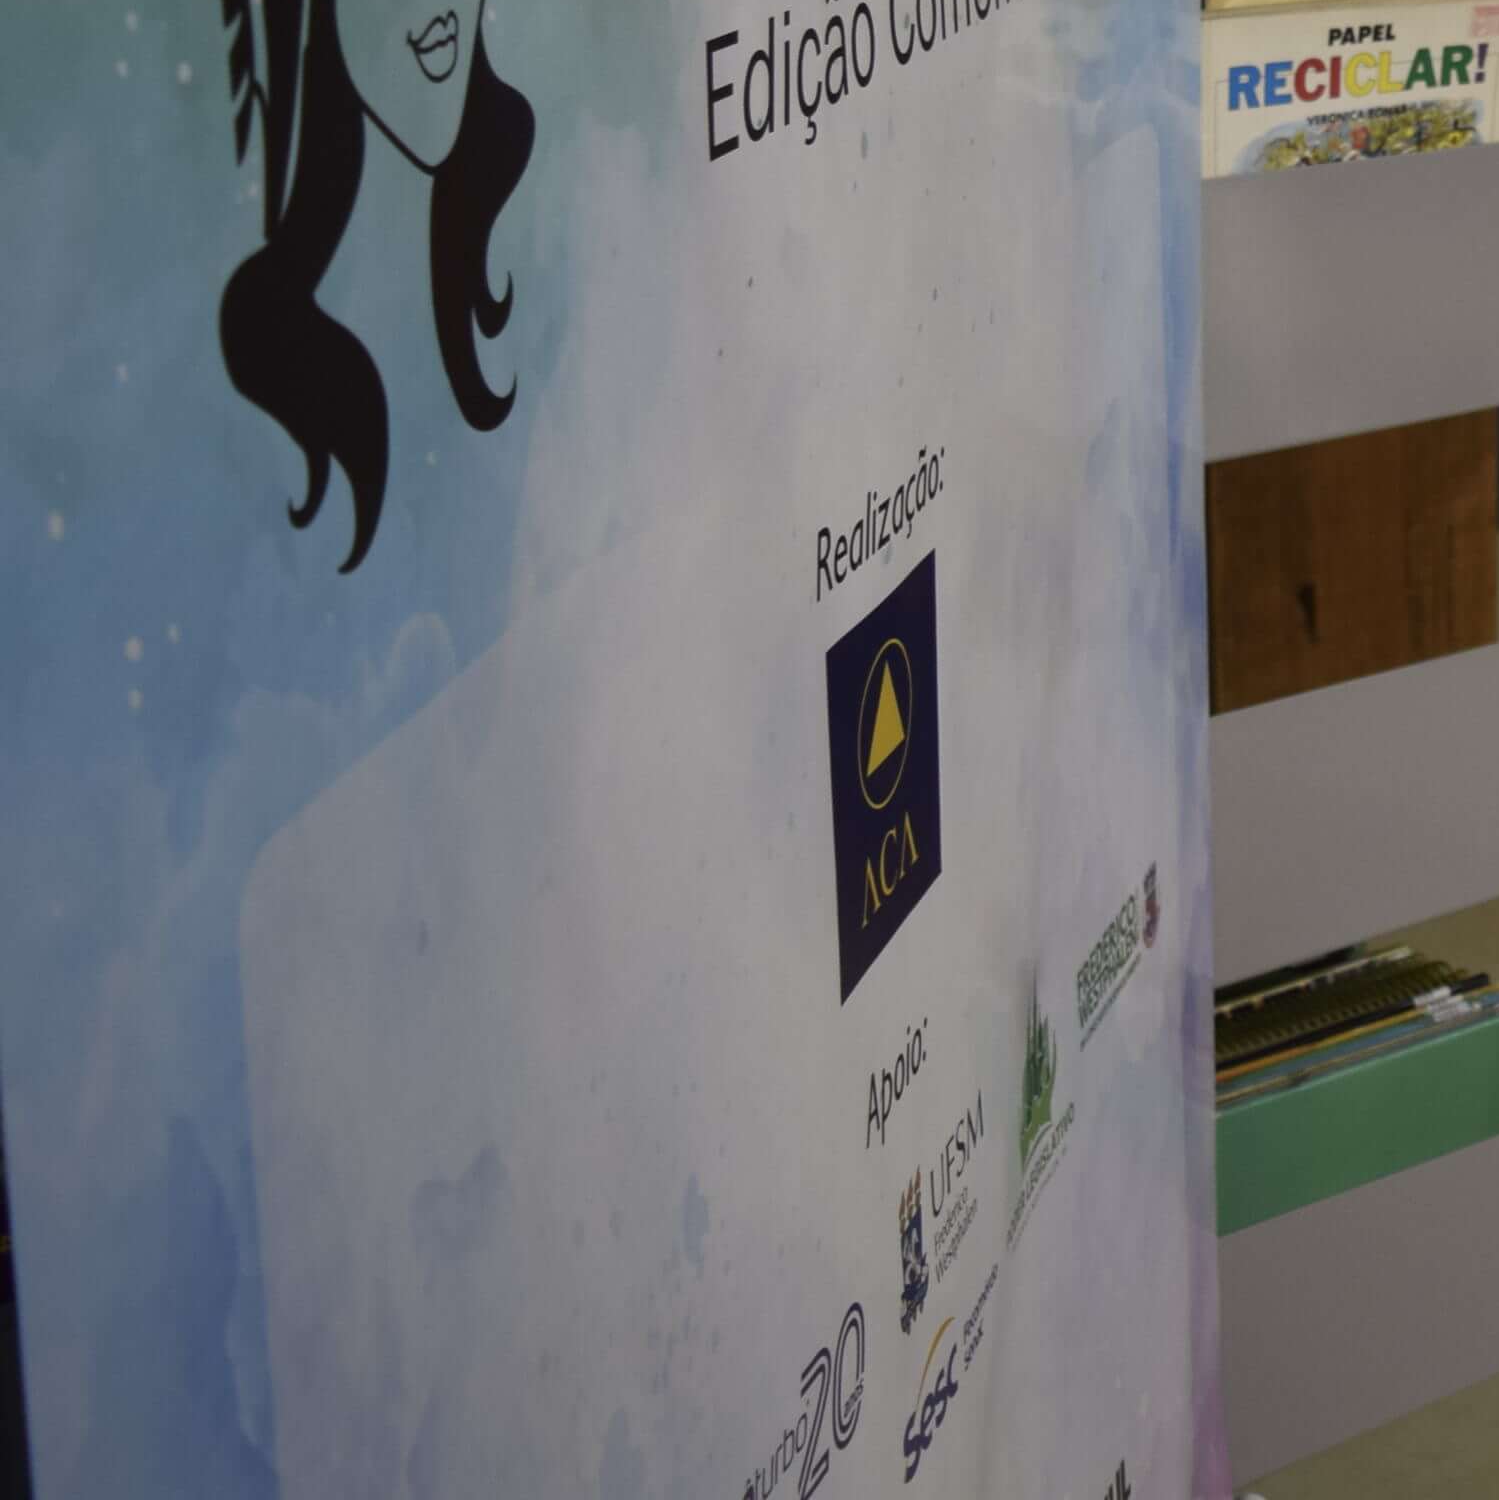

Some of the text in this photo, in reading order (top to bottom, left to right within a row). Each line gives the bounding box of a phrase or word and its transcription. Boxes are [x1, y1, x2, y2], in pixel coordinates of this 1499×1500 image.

[1227, 42, 1490, 111] RECICLAR!
[1327, 22, 1397, 47] PAPEL
[815, 444, 945, 604] Realização:
[865, 1016, 928, 1150] Apoio:
[930, 1088, 984, 1219] UFSM
